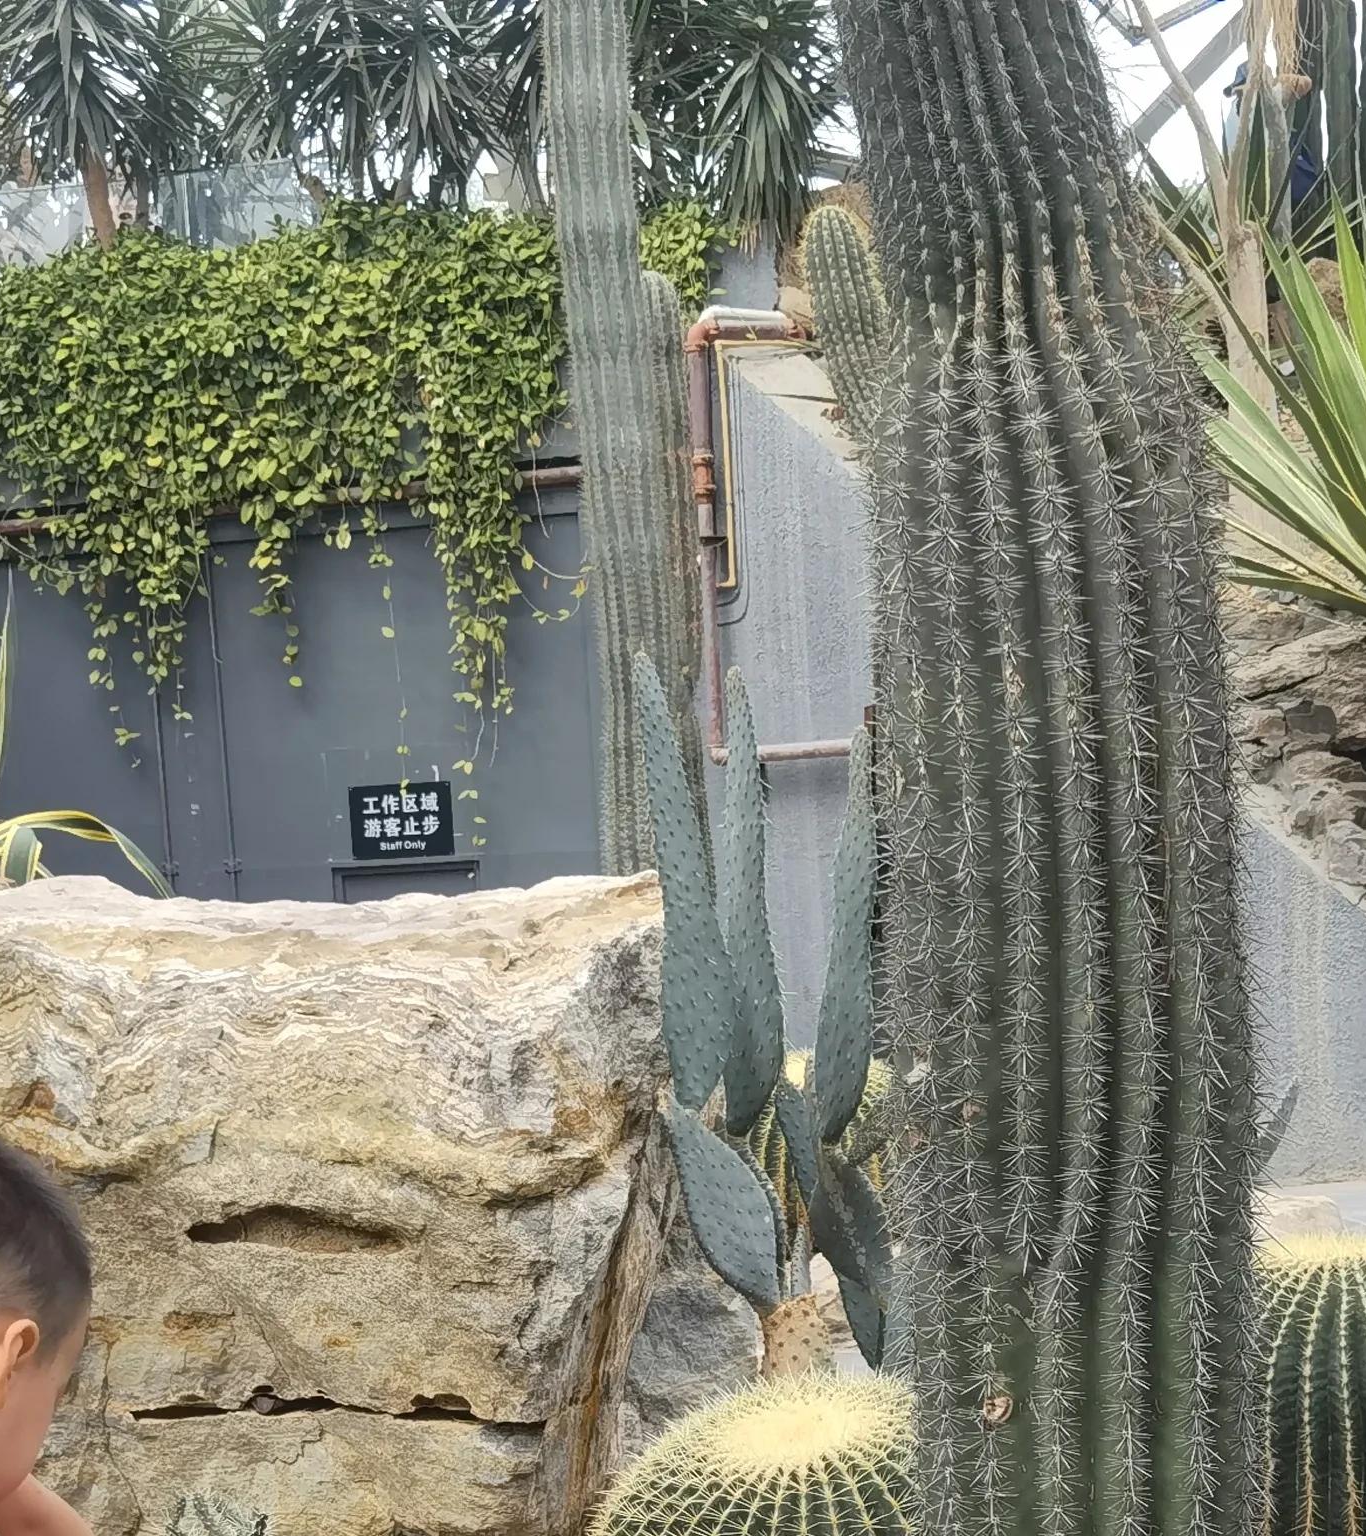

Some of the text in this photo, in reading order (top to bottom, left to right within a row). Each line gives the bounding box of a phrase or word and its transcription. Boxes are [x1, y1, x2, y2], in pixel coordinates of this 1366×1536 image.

[362, 792, 440, 815] 工作区域
[363, 814, 441, 838] 游客止步
[380, 840, 427, 851] Staff Only
